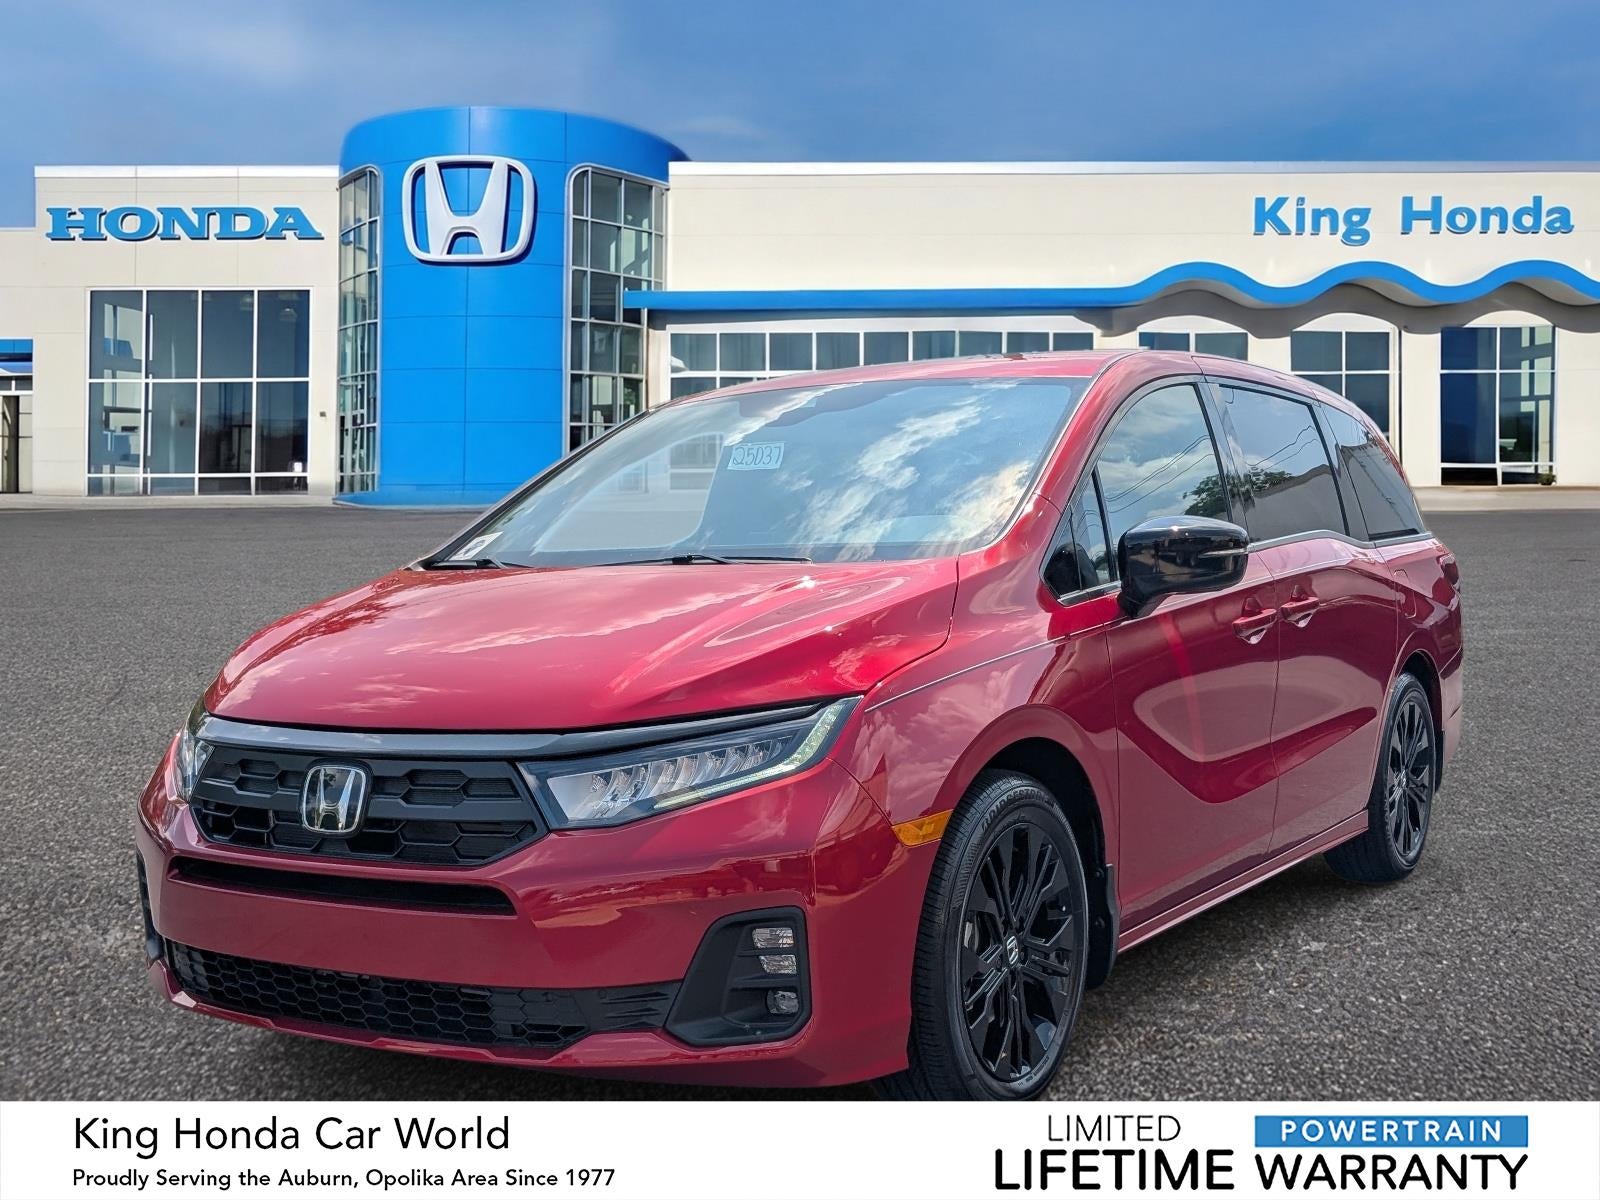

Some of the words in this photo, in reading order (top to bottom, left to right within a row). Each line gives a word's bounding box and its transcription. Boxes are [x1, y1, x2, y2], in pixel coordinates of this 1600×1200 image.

[46, 206, 325, 242] HONDA
[1253, 196, 1371, 246] King
[1401, 195, 1575, 235] Honda
